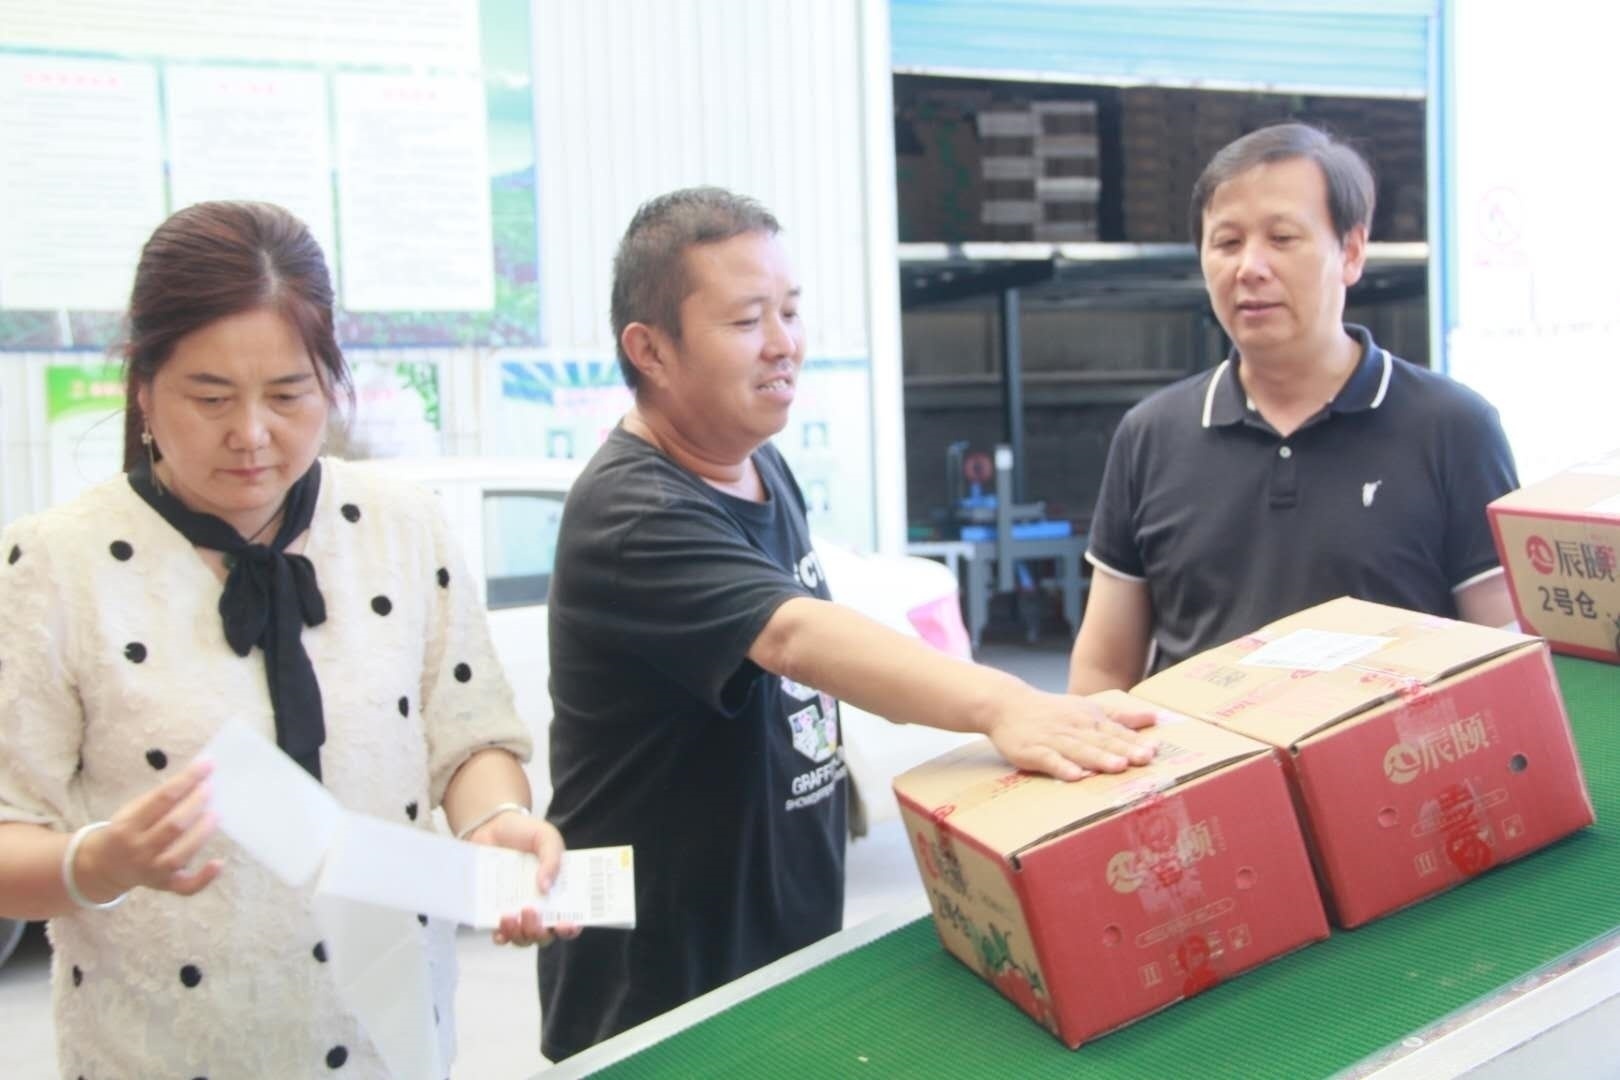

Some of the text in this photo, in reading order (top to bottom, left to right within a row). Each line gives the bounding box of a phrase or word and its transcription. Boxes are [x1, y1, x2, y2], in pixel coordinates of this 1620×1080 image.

[1554, 539, 1616, 582] 辰颐
[1537, 585, 1598, 619] 2号仓
[1419, 711, 1490, 773] 辰颐
